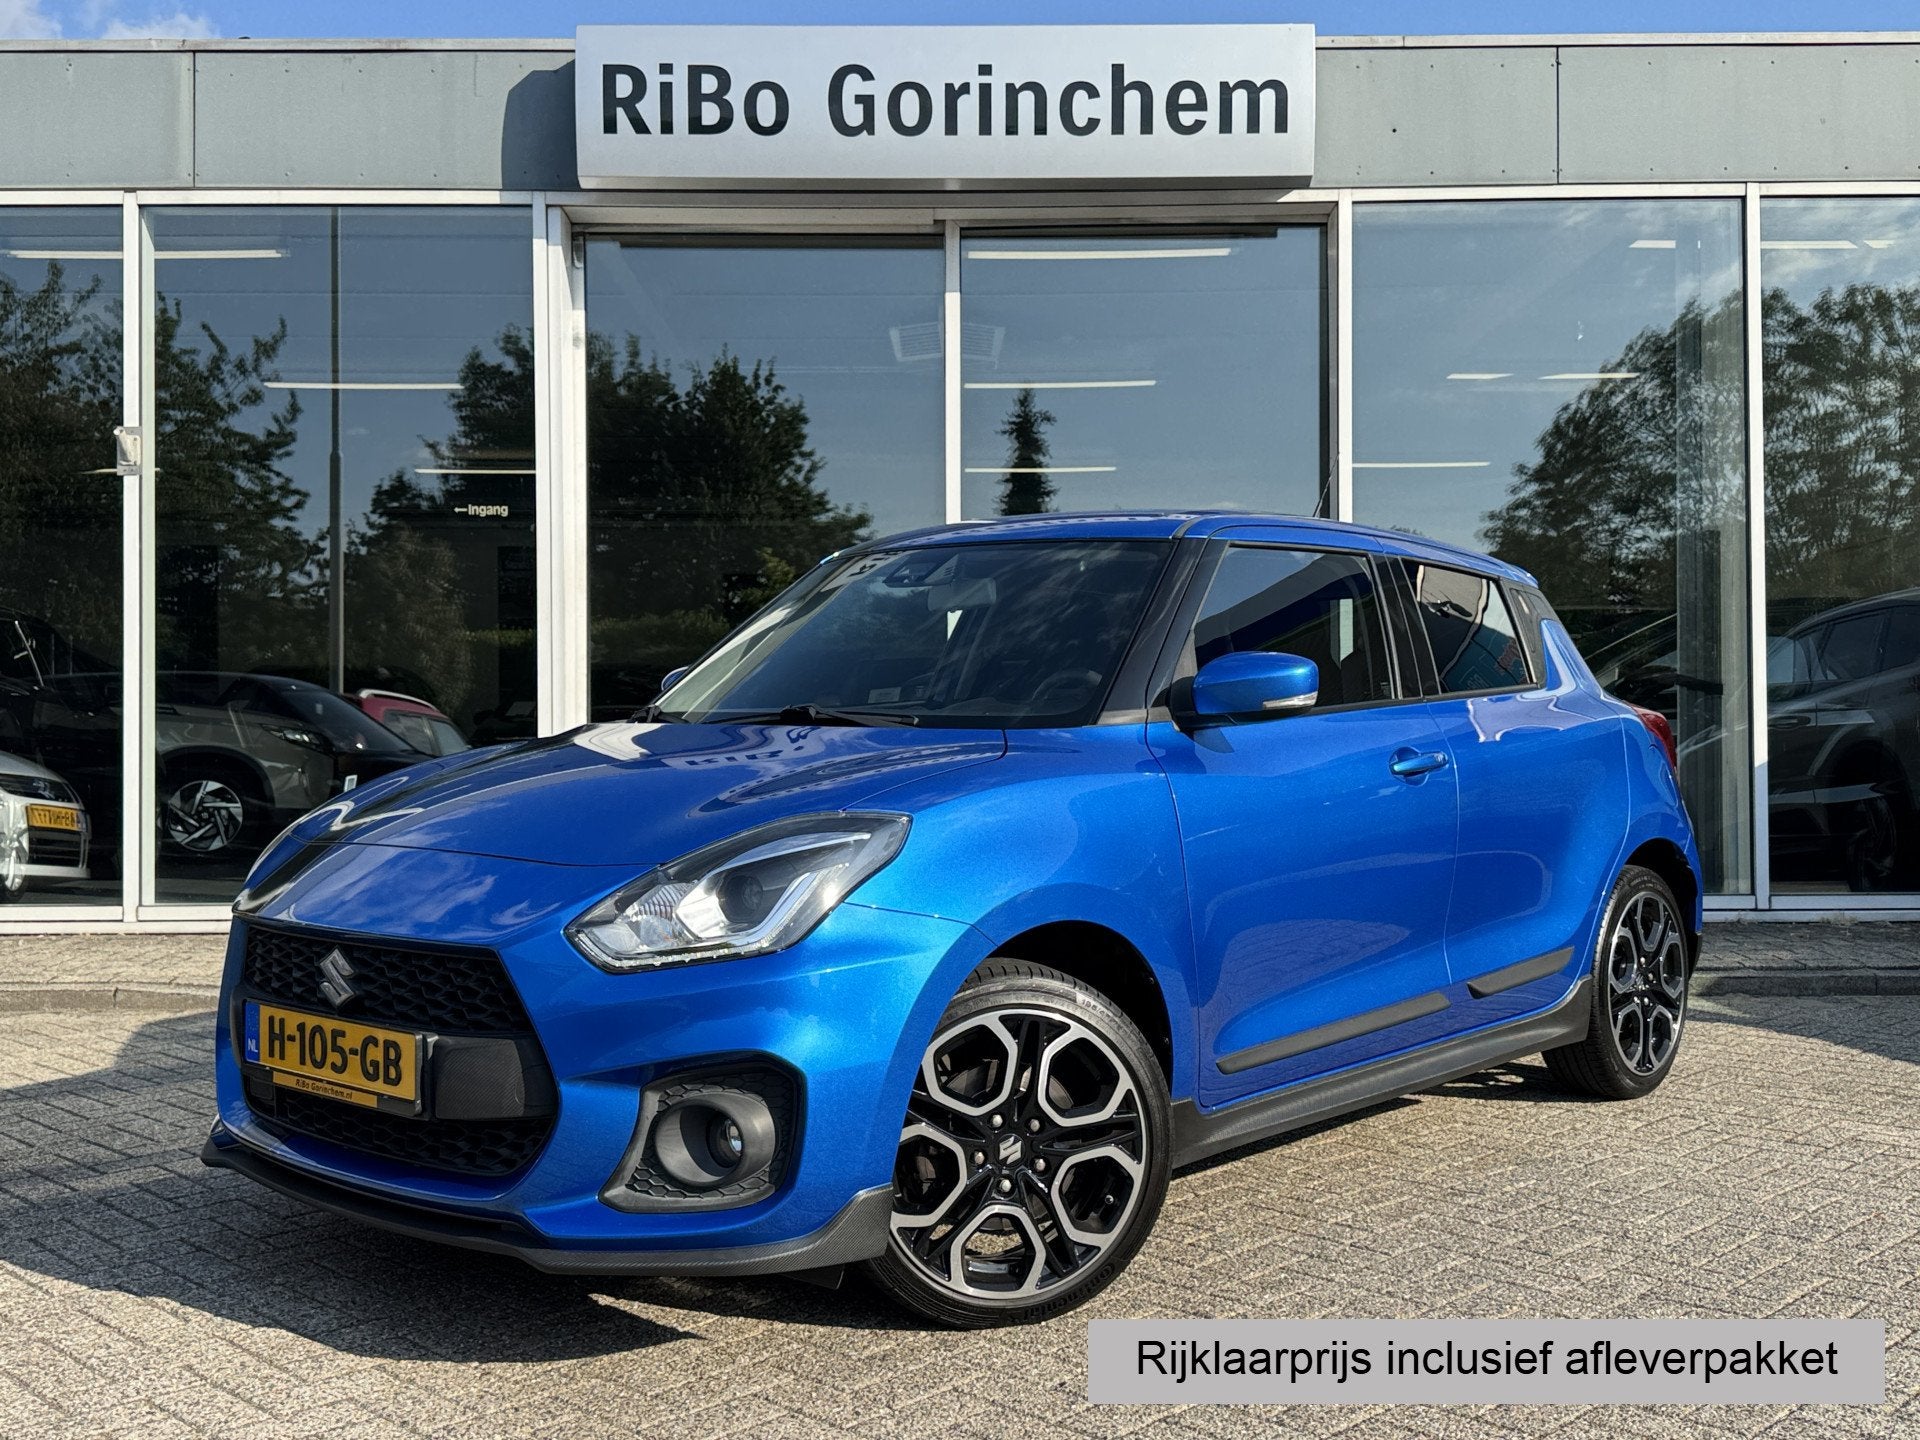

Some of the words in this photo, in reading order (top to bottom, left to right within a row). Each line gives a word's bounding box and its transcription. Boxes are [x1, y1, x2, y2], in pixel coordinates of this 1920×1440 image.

[603, 64, 789, 136] RiBo
[829, 64, 1287, 136] Gorinchem
[468, 504, 509, 517] Ingang
[247, 1038, 259, 1052] NL
[268, 1015, 402, 1086] H-105-GB
[295, 1079, 310, 1089] RiBo
[311, 1082, 353, 1100] Gorinchem.nl
